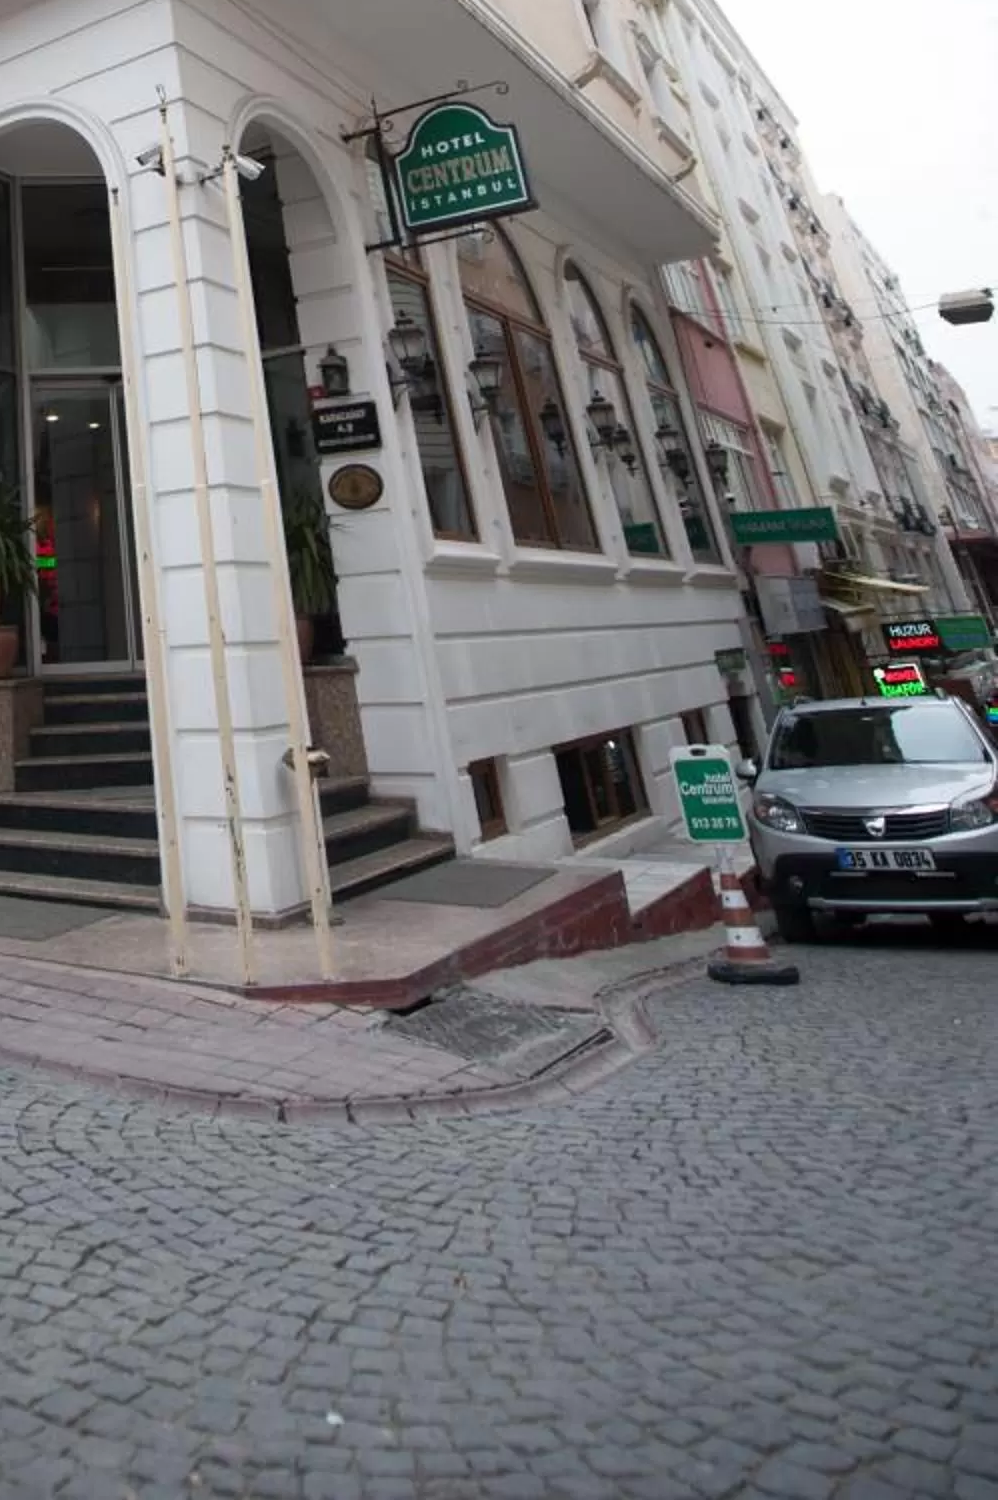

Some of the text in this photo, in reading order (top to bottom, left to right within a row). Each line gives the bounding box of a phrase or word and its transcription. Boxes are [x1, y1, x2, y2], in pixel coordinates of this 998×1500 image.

[421, 131, 486, 159] HOTEL
[407, 145, 514, 194] CENTRUM
[889, 623, 934, 637] HUZUR
[681, 781, 734, 796] Centrum
